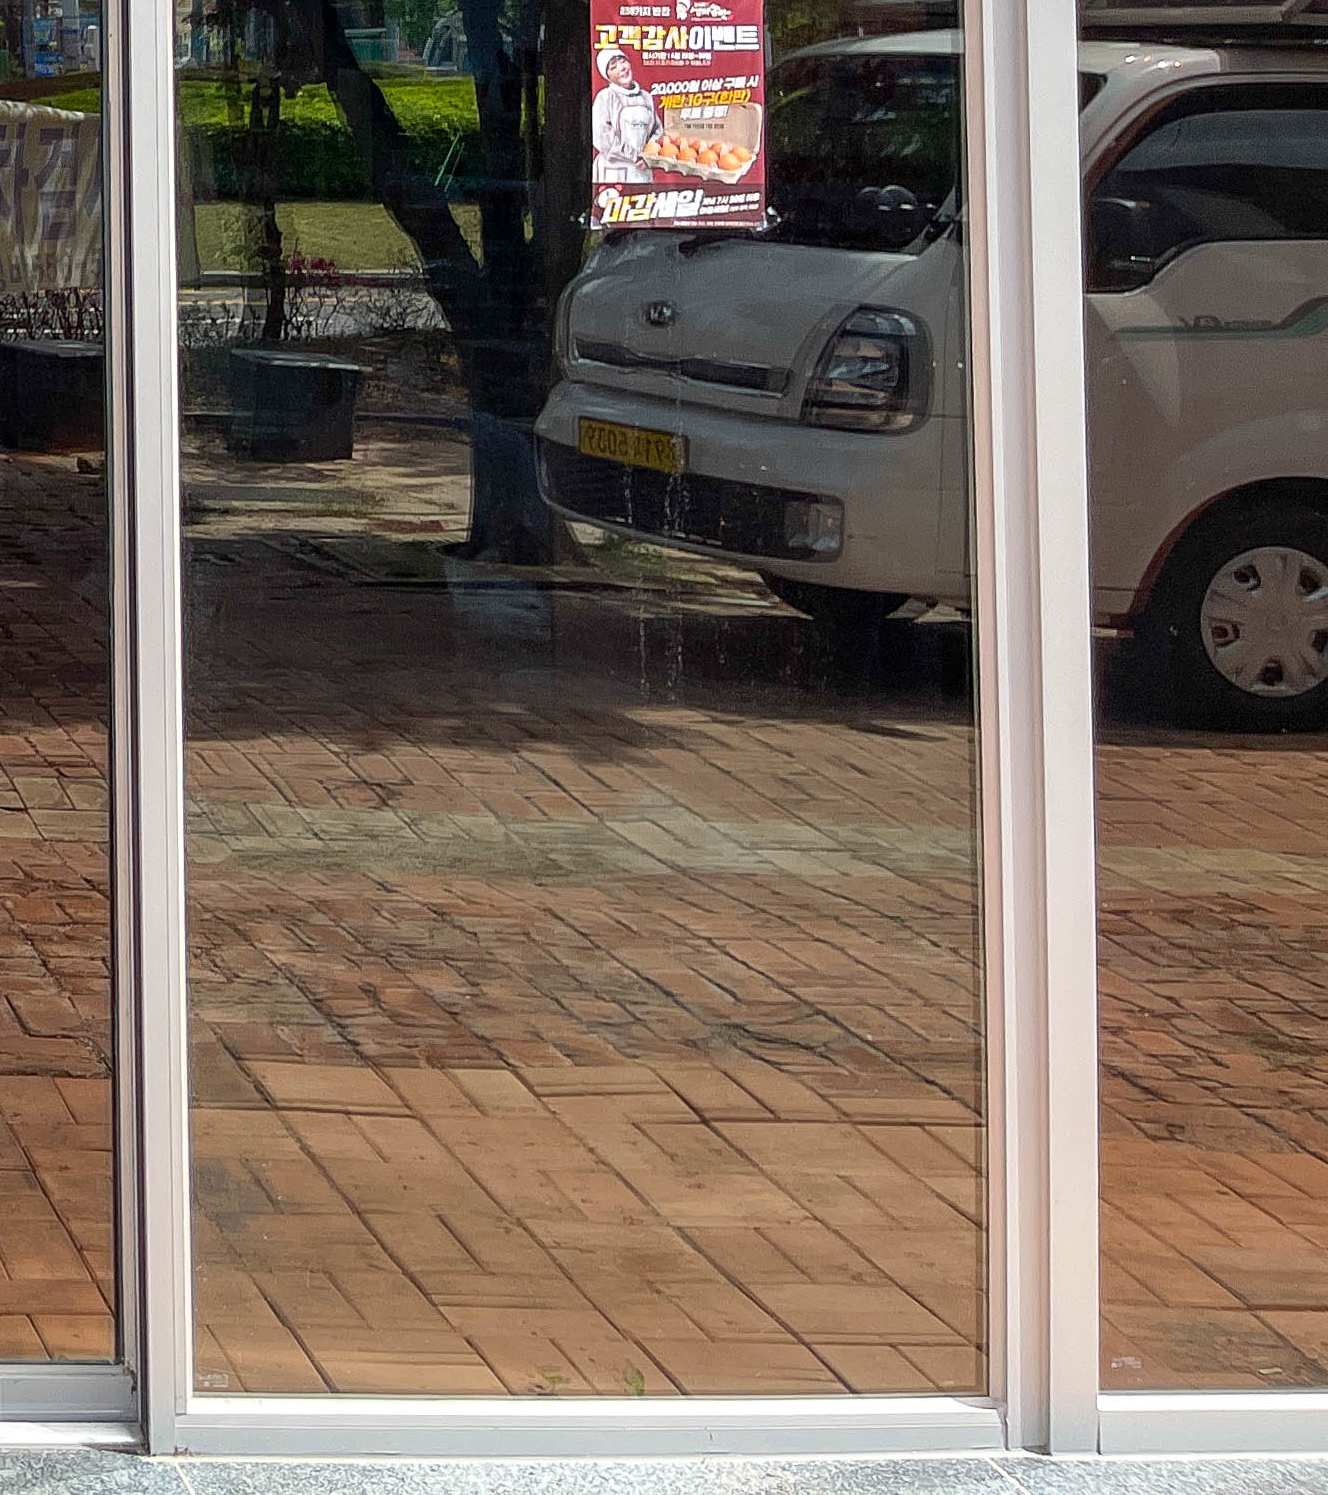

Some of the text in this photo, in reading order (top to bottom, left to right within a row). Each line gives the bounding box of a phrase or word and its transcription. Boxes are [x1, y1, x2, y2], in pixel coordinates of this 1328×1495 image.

[593, 24, 760, 51] 고객감사이벤트
[747, 74, 760, 88] 시
[600, 189, 704, 224] 마감세일
